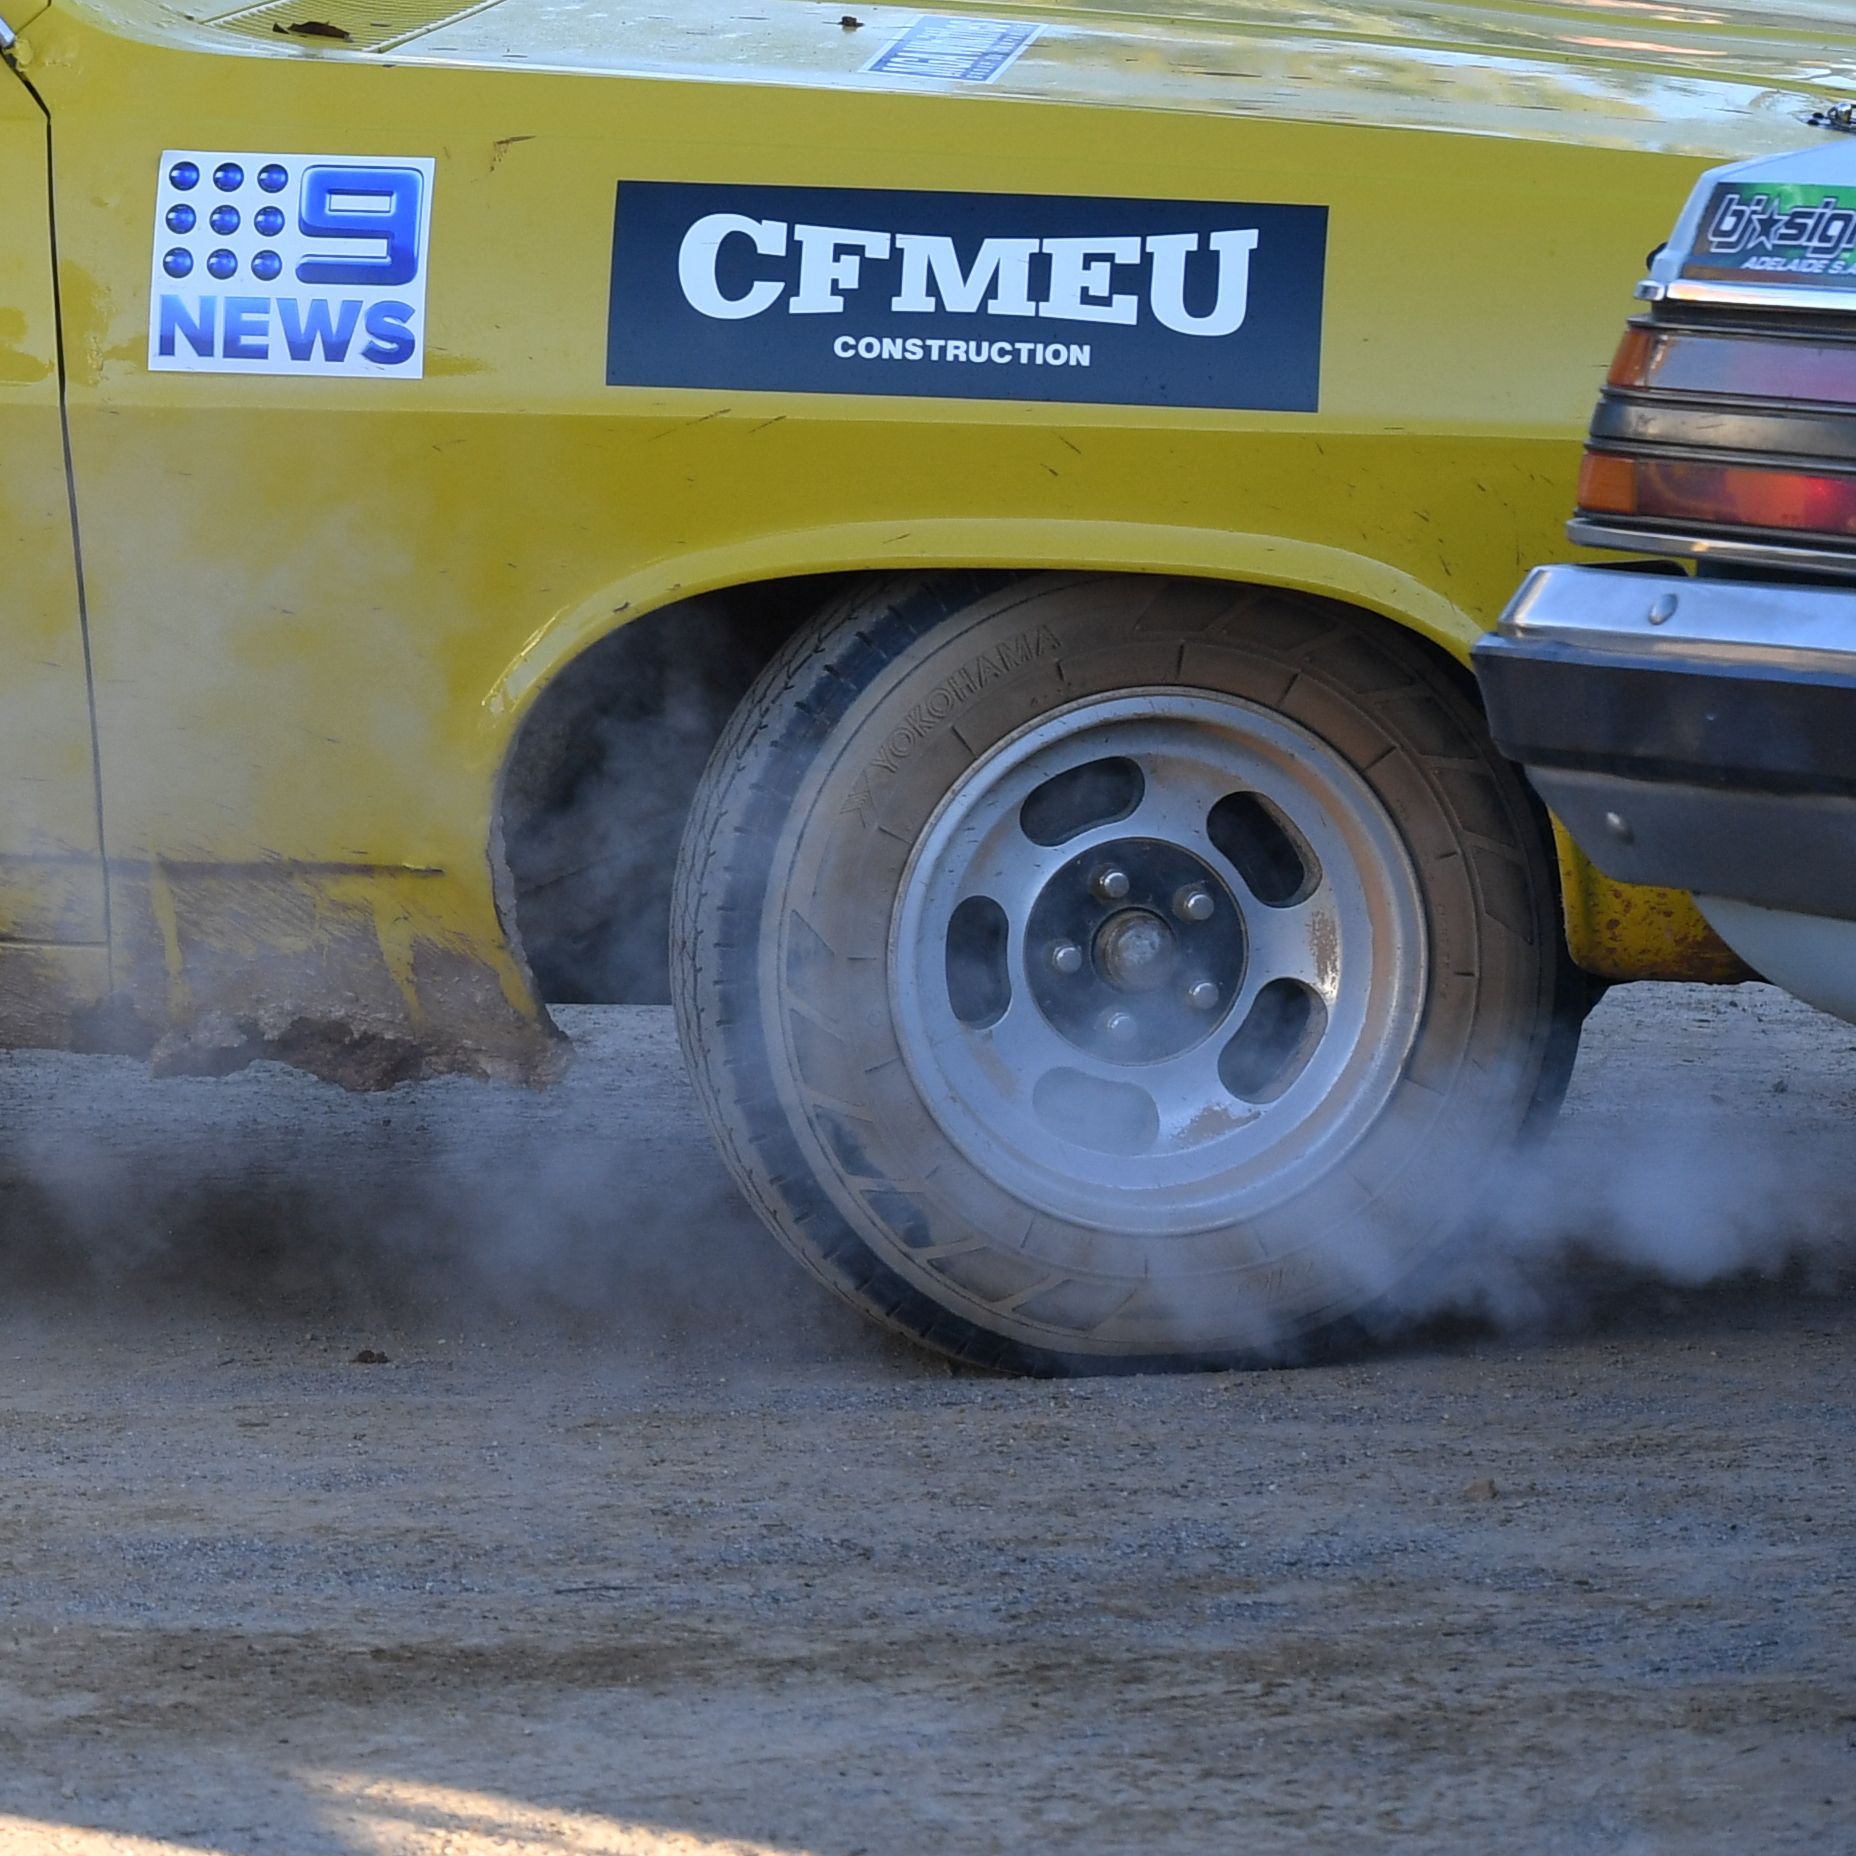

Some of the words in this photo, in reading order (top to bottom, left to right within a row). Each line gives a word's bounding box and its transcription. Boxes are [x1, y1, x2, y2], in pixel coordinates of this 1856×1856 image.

[295, 163, 424, 286] 9
[1741, 256, 1830, 274] ADELAIDE
[678, 213, 1259, 338] CFMEU
[157, 295, 417, 366] NEWS
[833, 334, 1091, 367] CONSTRUCTION
[869, 624, 1062, 775] YOKOHAMA
